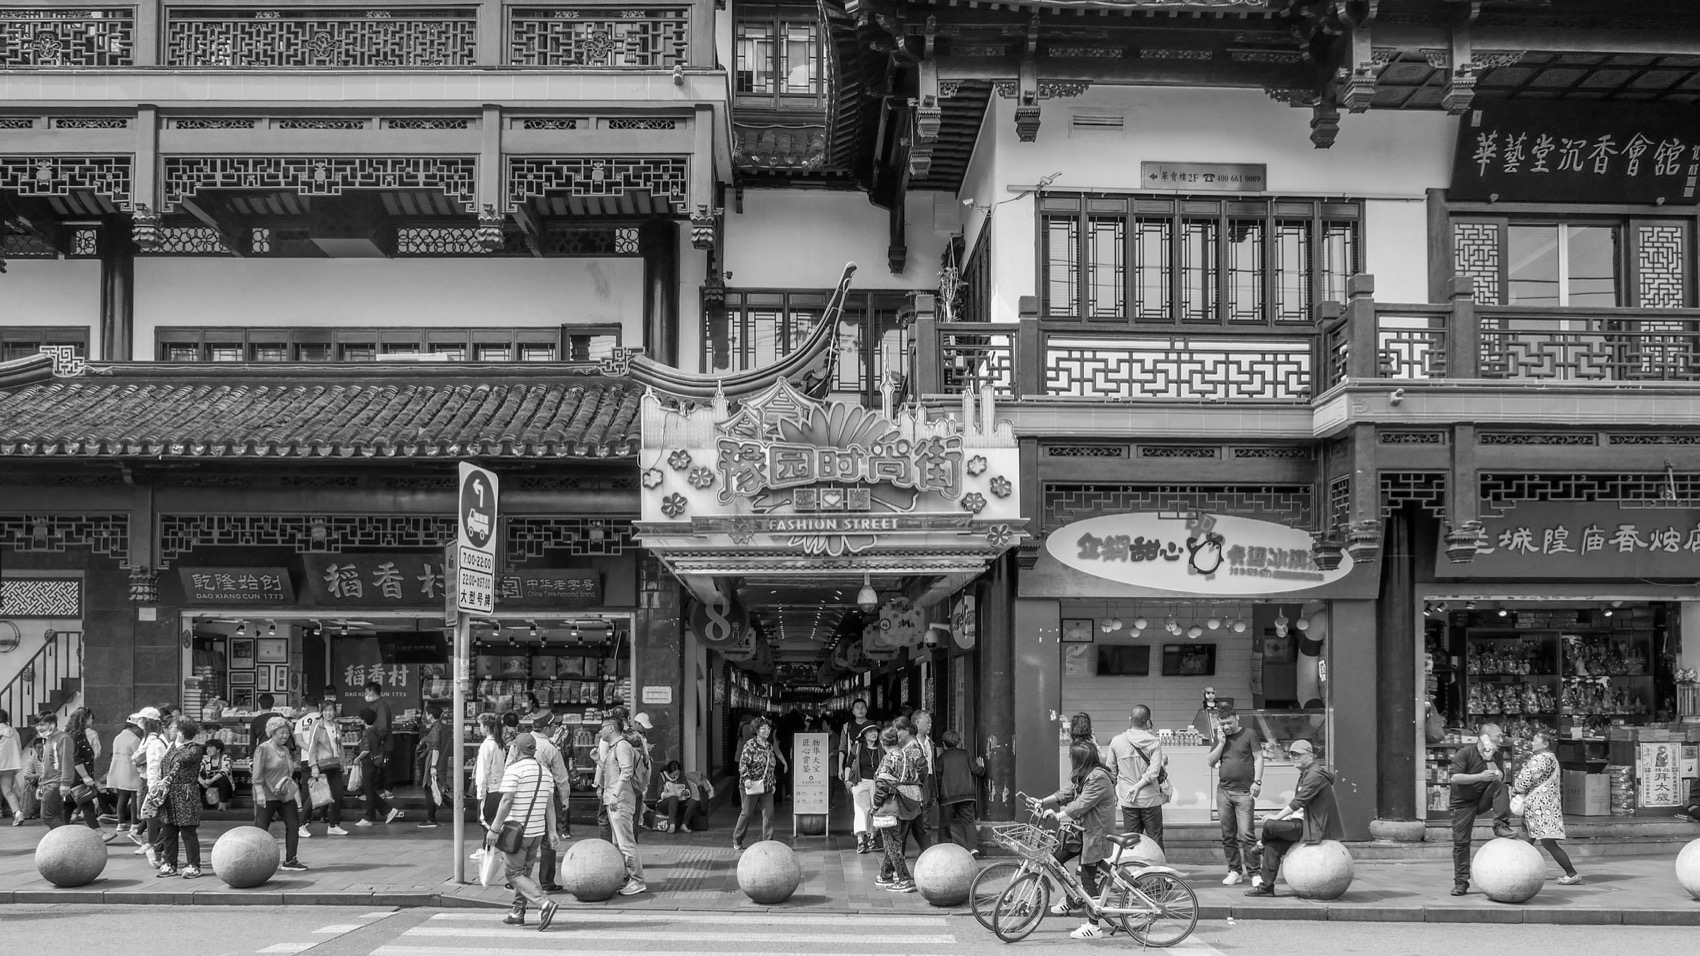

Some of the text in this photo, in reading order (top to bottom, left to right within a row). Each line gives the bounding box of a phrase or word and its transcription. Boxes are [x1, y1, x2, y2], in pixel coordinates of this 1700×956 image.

[1217, 174, 1229, 183] 400
[1231, 174, 1242, 183] 661
[717, 437, 963, 505] 豫园时尚街
[769, 519, 899, 531] FASHION STREET
[463, 552, 491, 569] 7:00-22:00
[192, 573, 282, 591] 乾隆始创
[526, 579, 595, 591] 中华老字号
[461, 589, 491, 608] 大型号牌
[705, 588, 731, 641] 8
[344, 663, 409, 687] 稻香村
